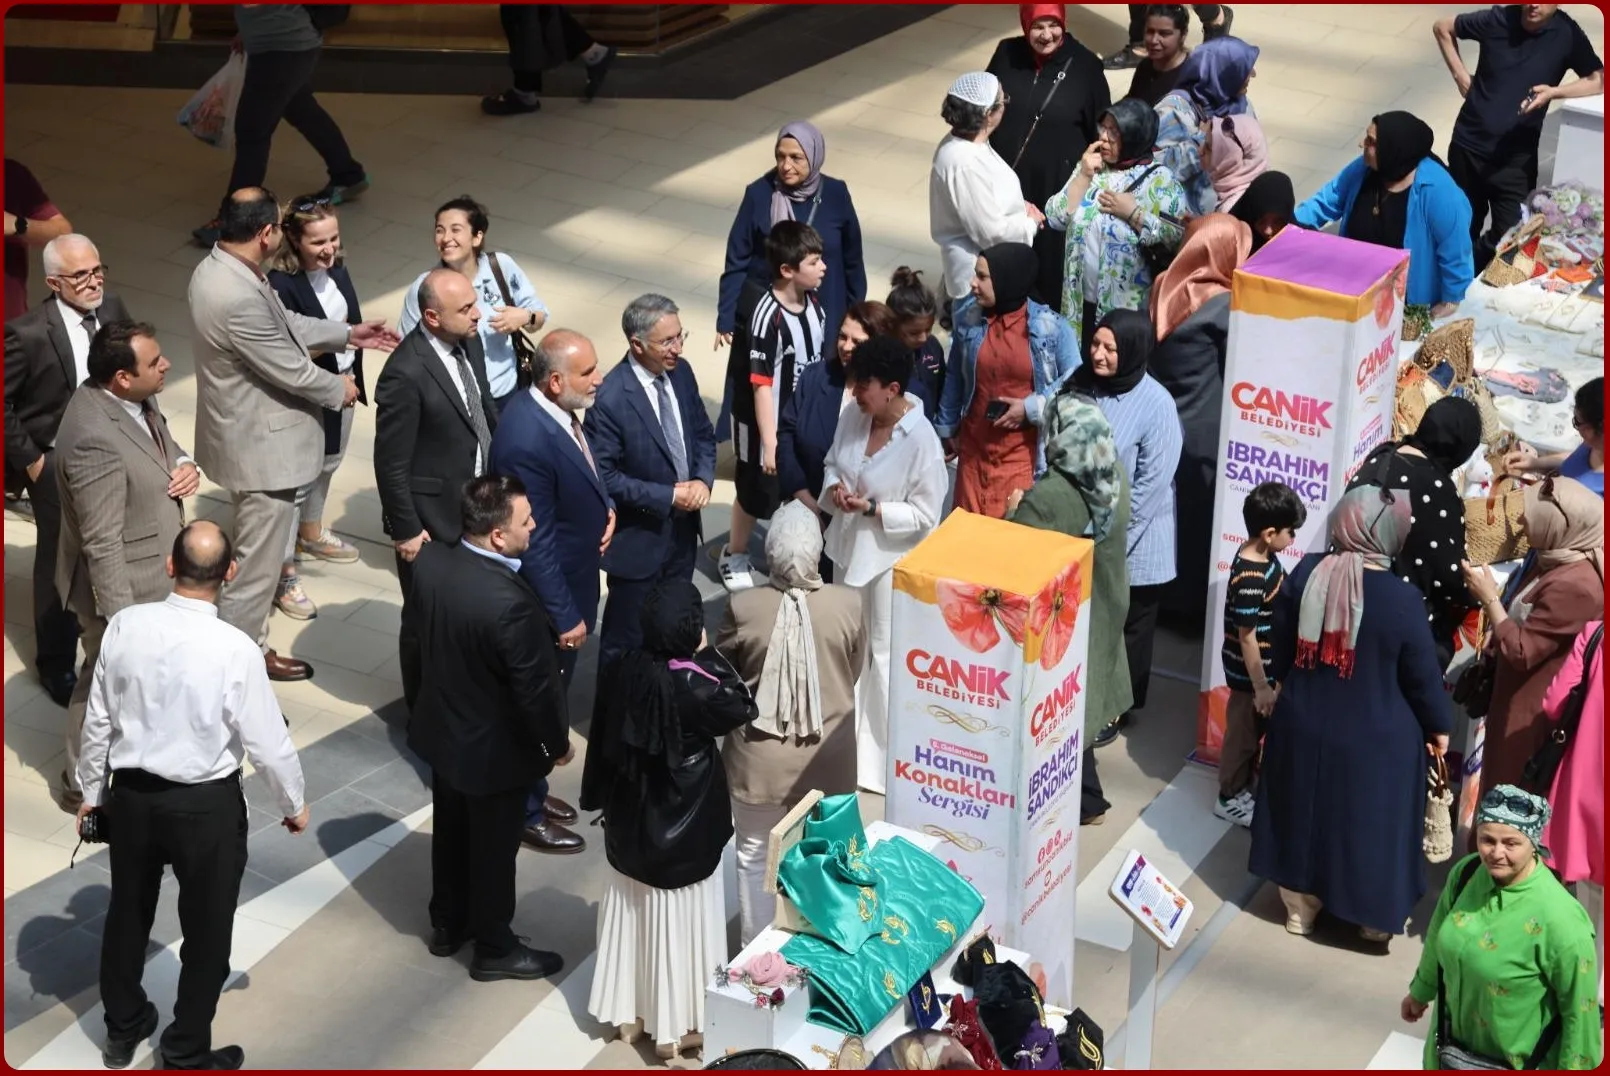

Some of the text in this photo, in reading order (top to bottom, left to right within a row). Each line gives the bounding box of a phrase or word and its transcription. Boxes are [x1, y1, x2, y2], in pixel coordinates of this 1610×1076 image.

[915, 745, 996, 783] Hanım
[895, 760, 1016, 809] Konakları
[918, 786, 991, 820] Sergisi
